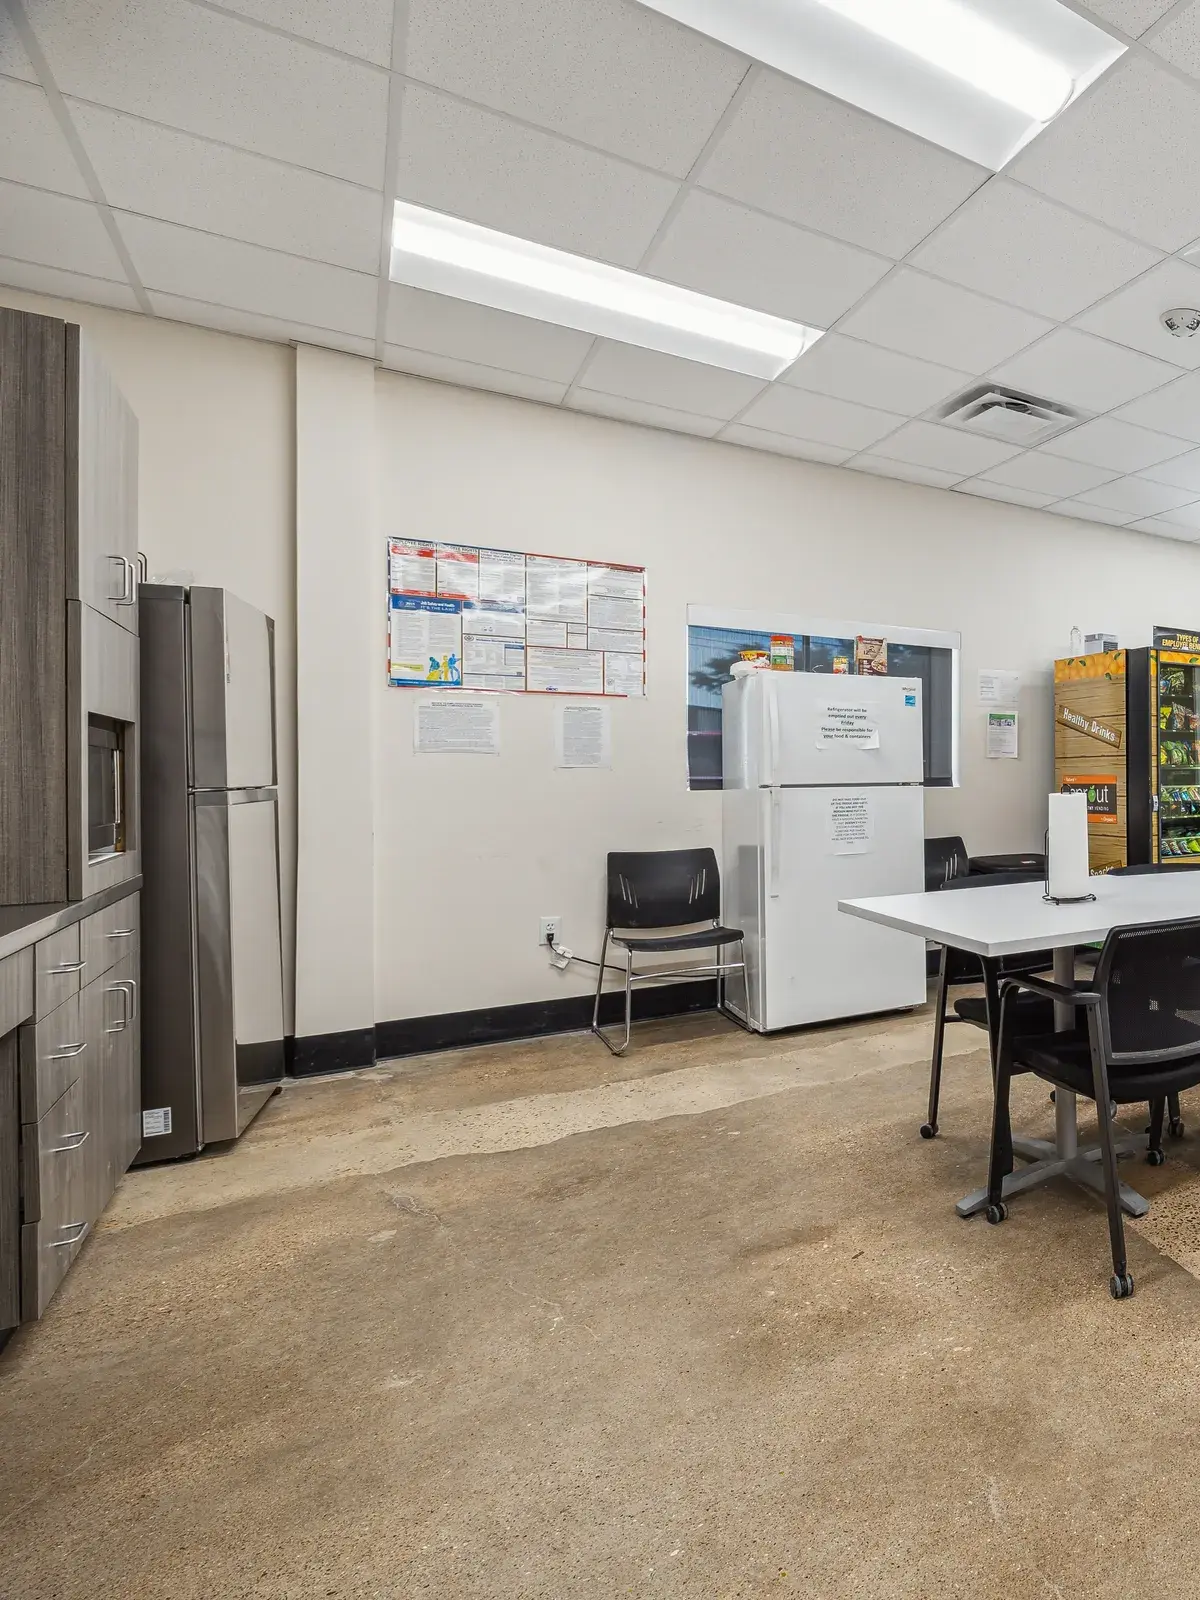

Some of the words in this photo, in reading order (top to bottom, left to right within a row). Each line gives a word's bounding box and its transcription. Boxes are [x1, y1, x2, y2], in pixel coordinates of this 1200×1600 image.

[1177, 633, 1192, 642] TYPES
[1162, 639, 1188, 648] EMPLOYEE
[1063, 708, 1089, 730] Healthy
[1091, 720, 1115, 741] Drinks
